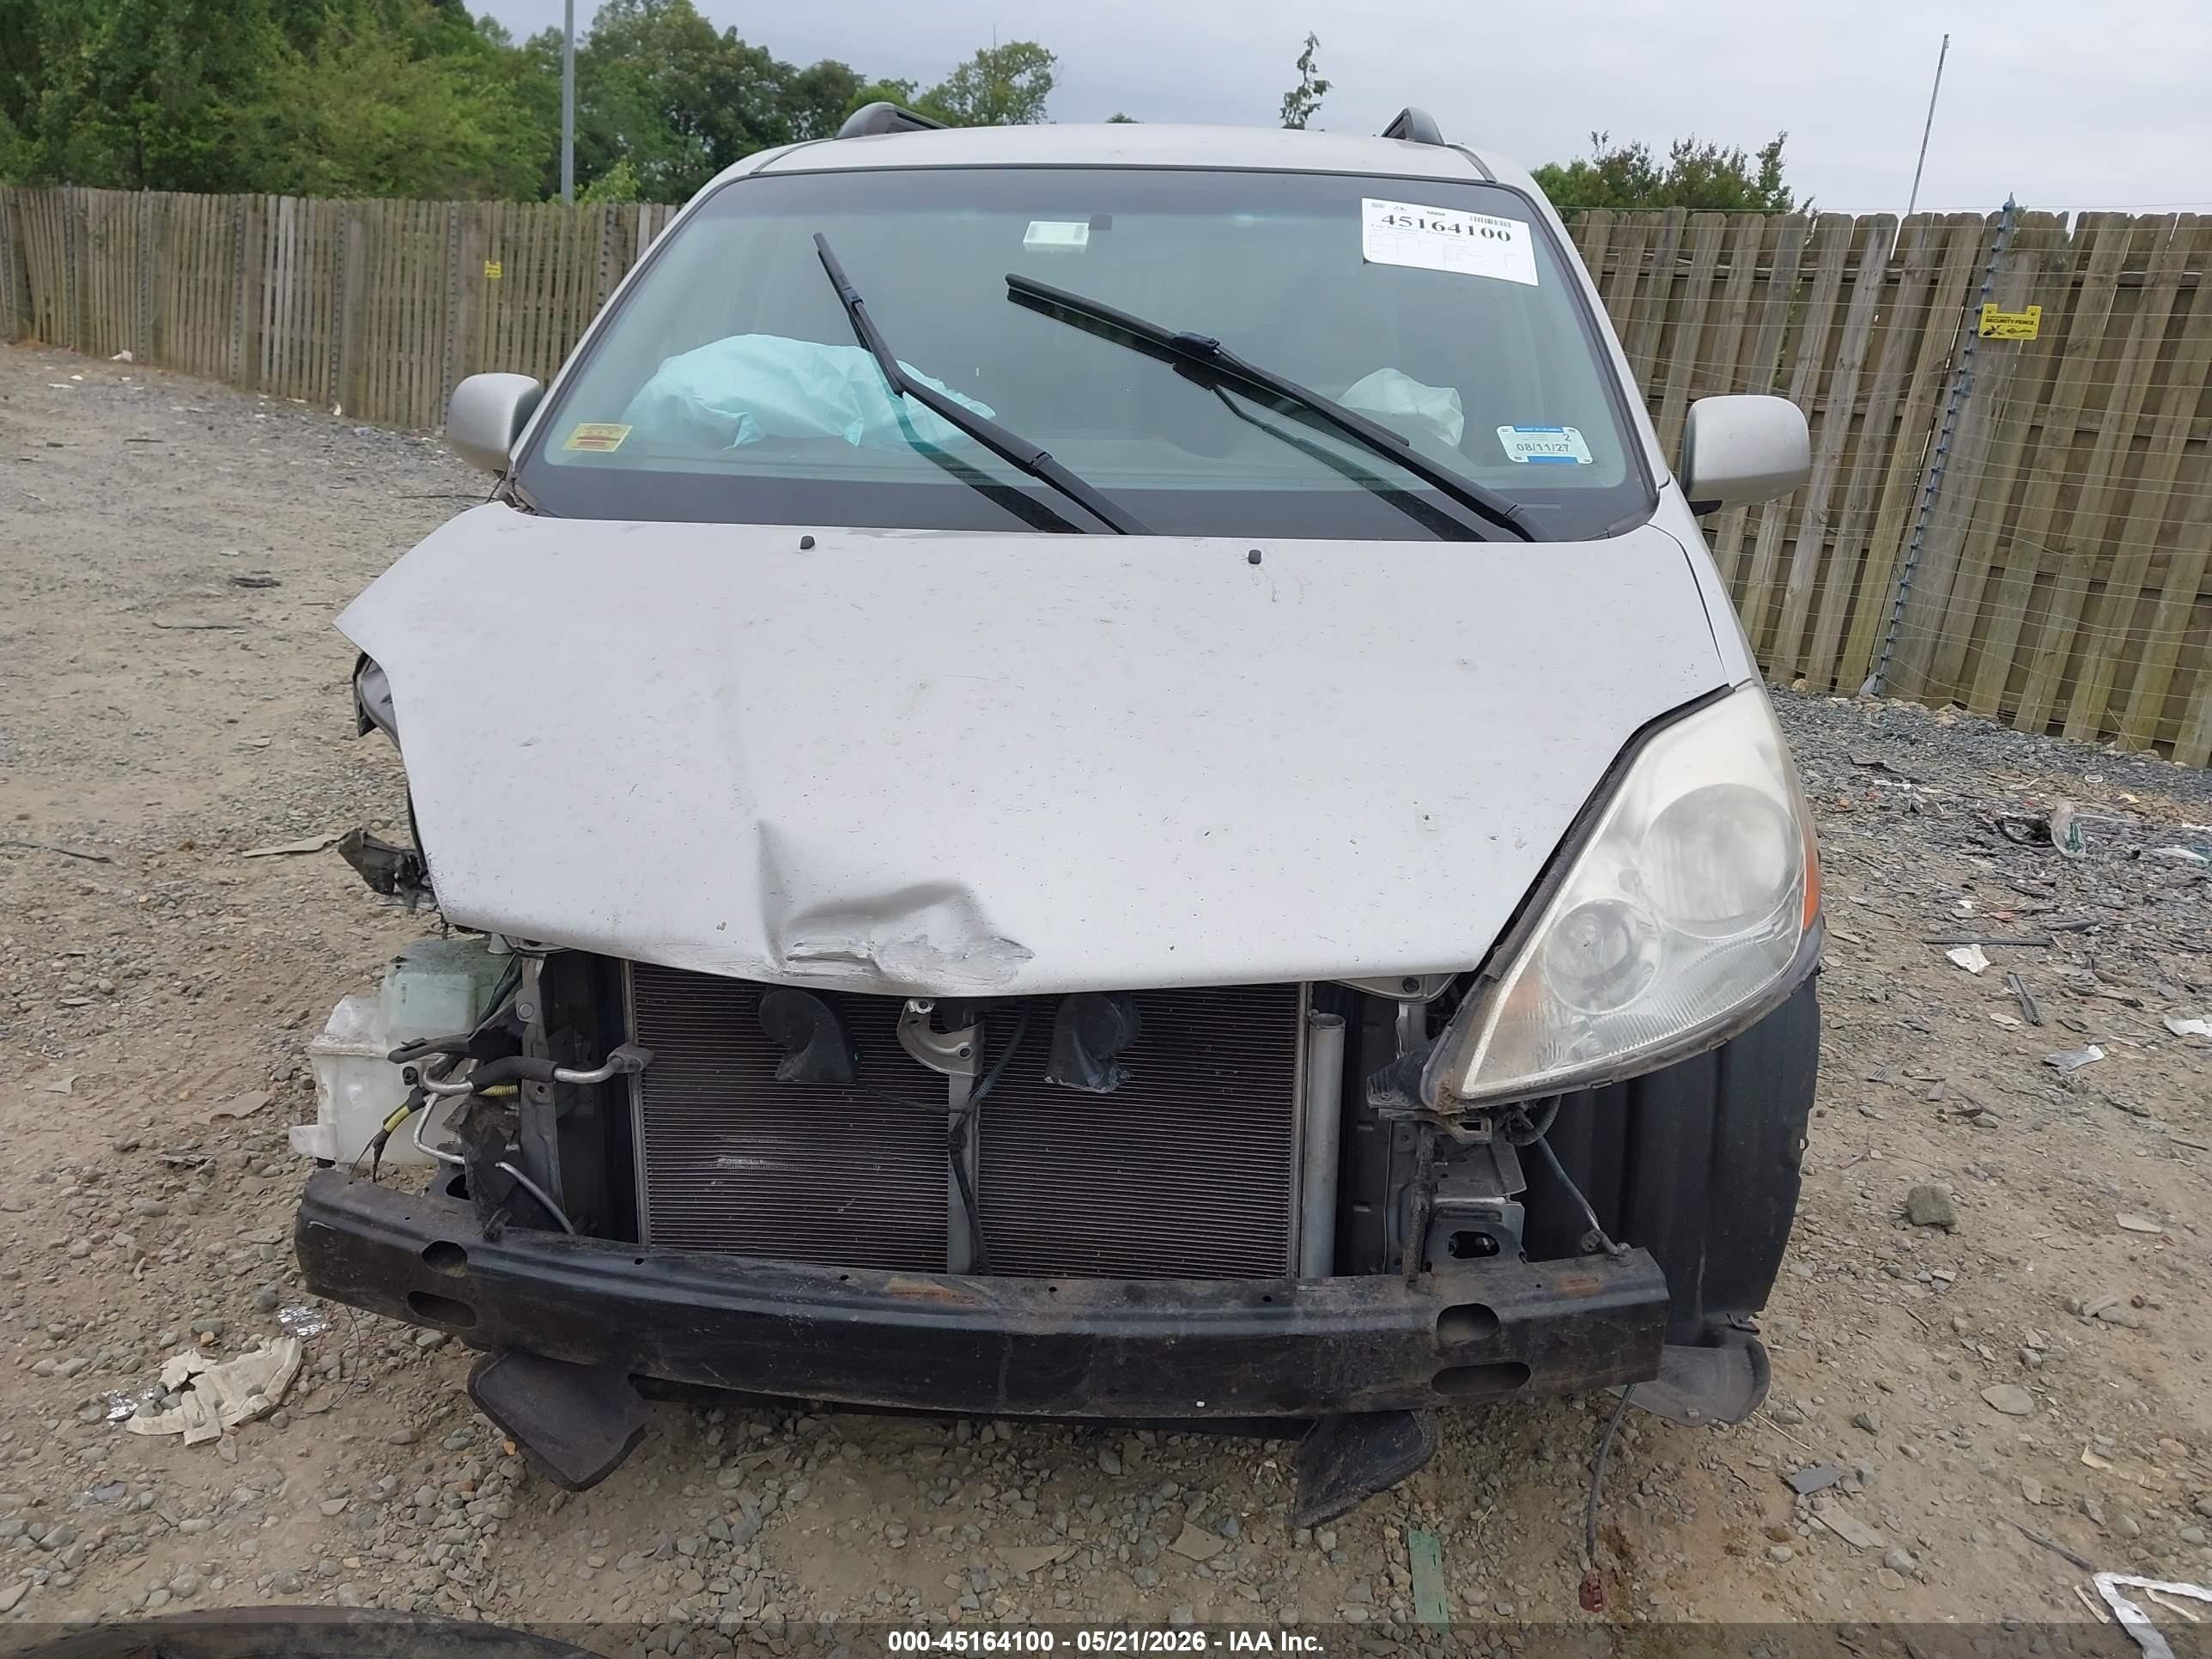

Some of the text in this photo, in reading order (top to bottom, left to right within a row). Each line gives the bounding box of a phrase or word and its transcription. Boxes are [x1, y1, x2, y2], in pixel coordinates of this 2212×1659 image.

[1381, 213, 1511, 242] 45164100
[1563, 433, 1571, 441] 2
[1516, 443, 1570, 452] 08/11/27
